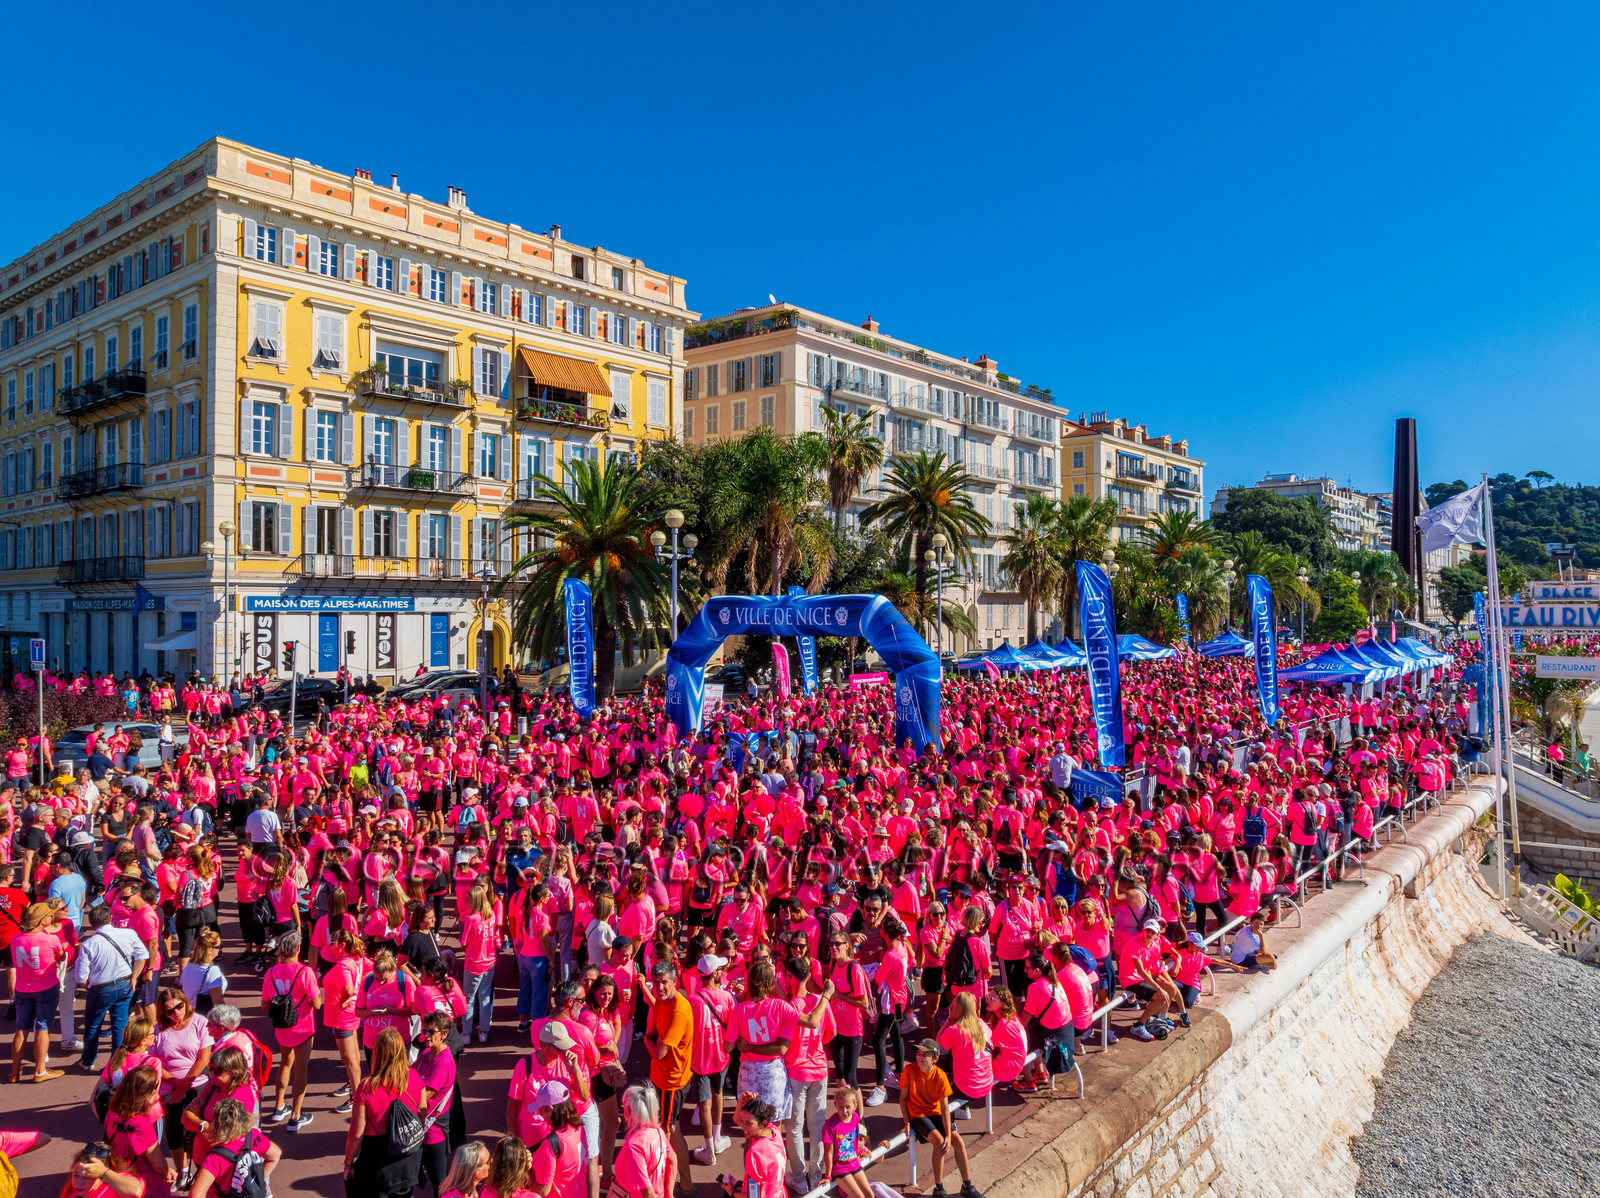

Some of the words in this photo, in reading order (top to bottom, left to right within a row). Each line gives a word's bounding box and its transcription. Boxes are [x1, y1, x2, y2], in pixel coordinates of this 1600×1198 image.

[72, 600, 92, 609] MAISON
[93, 600, 104, 609] DES
[254, 599, 298, 608] MAISON
[300, 600, 320, 608] DES
[322, 600, 409, 609] ALPES-MARITIMES
[1542, 587, 1593, 598] PLAGE
[571, 599, 587, 633] NICE
[735, 607, 771, 625] VILLE
[774, 607, 793, 626] DE
[796, 606, 832, 626] NICE
[1086, 591, 1109, 640] NICE
[1257, 596, 1269, 633] NICE
[256, 615, 273, 671] VOUS
[378, 615, 392, 667] VOUS
[572, 637, 587, 656] DE
[1260, 636, 1272, 657] DE
[803, 648, 814, 678] VILLE
[1089, 644, 1111, 672] DE
[1541, 662, 1597, 672] RESTAURANT
[572, 658, 588, 696] VILLE
[1261, 660, 1275, 699] VILLE
[1094, 677, 1114, 730] VILLE
[15, 945, 40, 968] N
[747, 1016, 771, 1043] N
